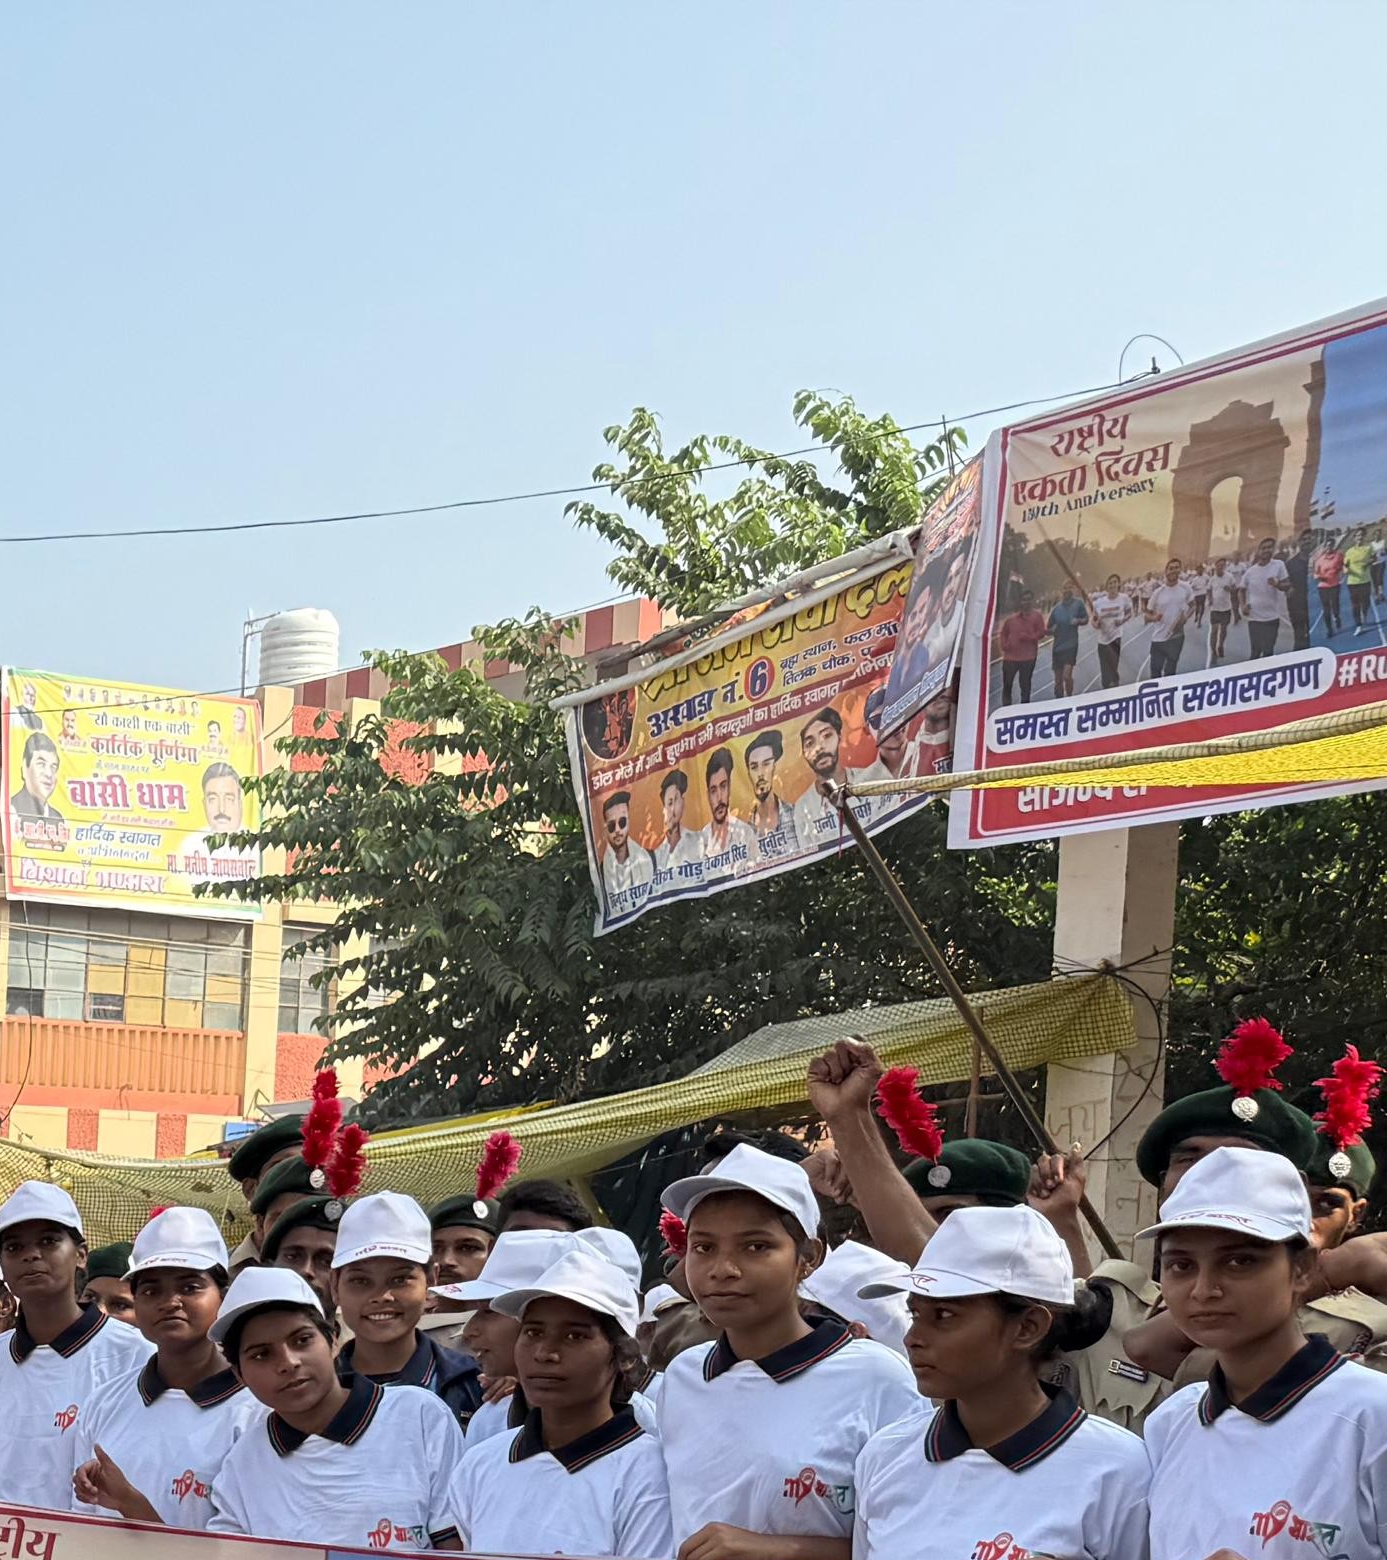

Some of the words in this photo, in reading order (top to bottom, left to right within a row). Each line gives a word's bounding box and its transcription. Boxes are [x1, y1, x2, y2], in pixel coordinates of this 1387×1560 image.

[1049, 409, 1132, 458] राष्ट्रीय
[1011, 464, 1088, 507] एकता
[1091, 440, 1174, 489] दिवस
[1062, 475, 1157, 512] Anniversary
[843, 627, 871, 647] फल
[749, 659, 770, 699] 6
[782, 665, 817, 687] तिलक
[754, 708, 768, 724] का
[770, 695, 802, 721] हार्दिक
[804, 680, 840, 704] स्वागत
[994, 708, 1069, 747] समस्त
[1076, 680, 1177, 732] सम्मानित
[1182, 657, 1325, 714] सभासदगण
[90, 733, 143, 757] कार्तिक
[147, 737, 200, 769] पूर्णिमा
[66, 772, 131, 809] बांसी
[135, 781, 189, 812] धाम
[74, 823, 115, 843] हार्दिक
[119, 829, 162, 848] स्वागत
[731, 842, 747, 862] सिंह
